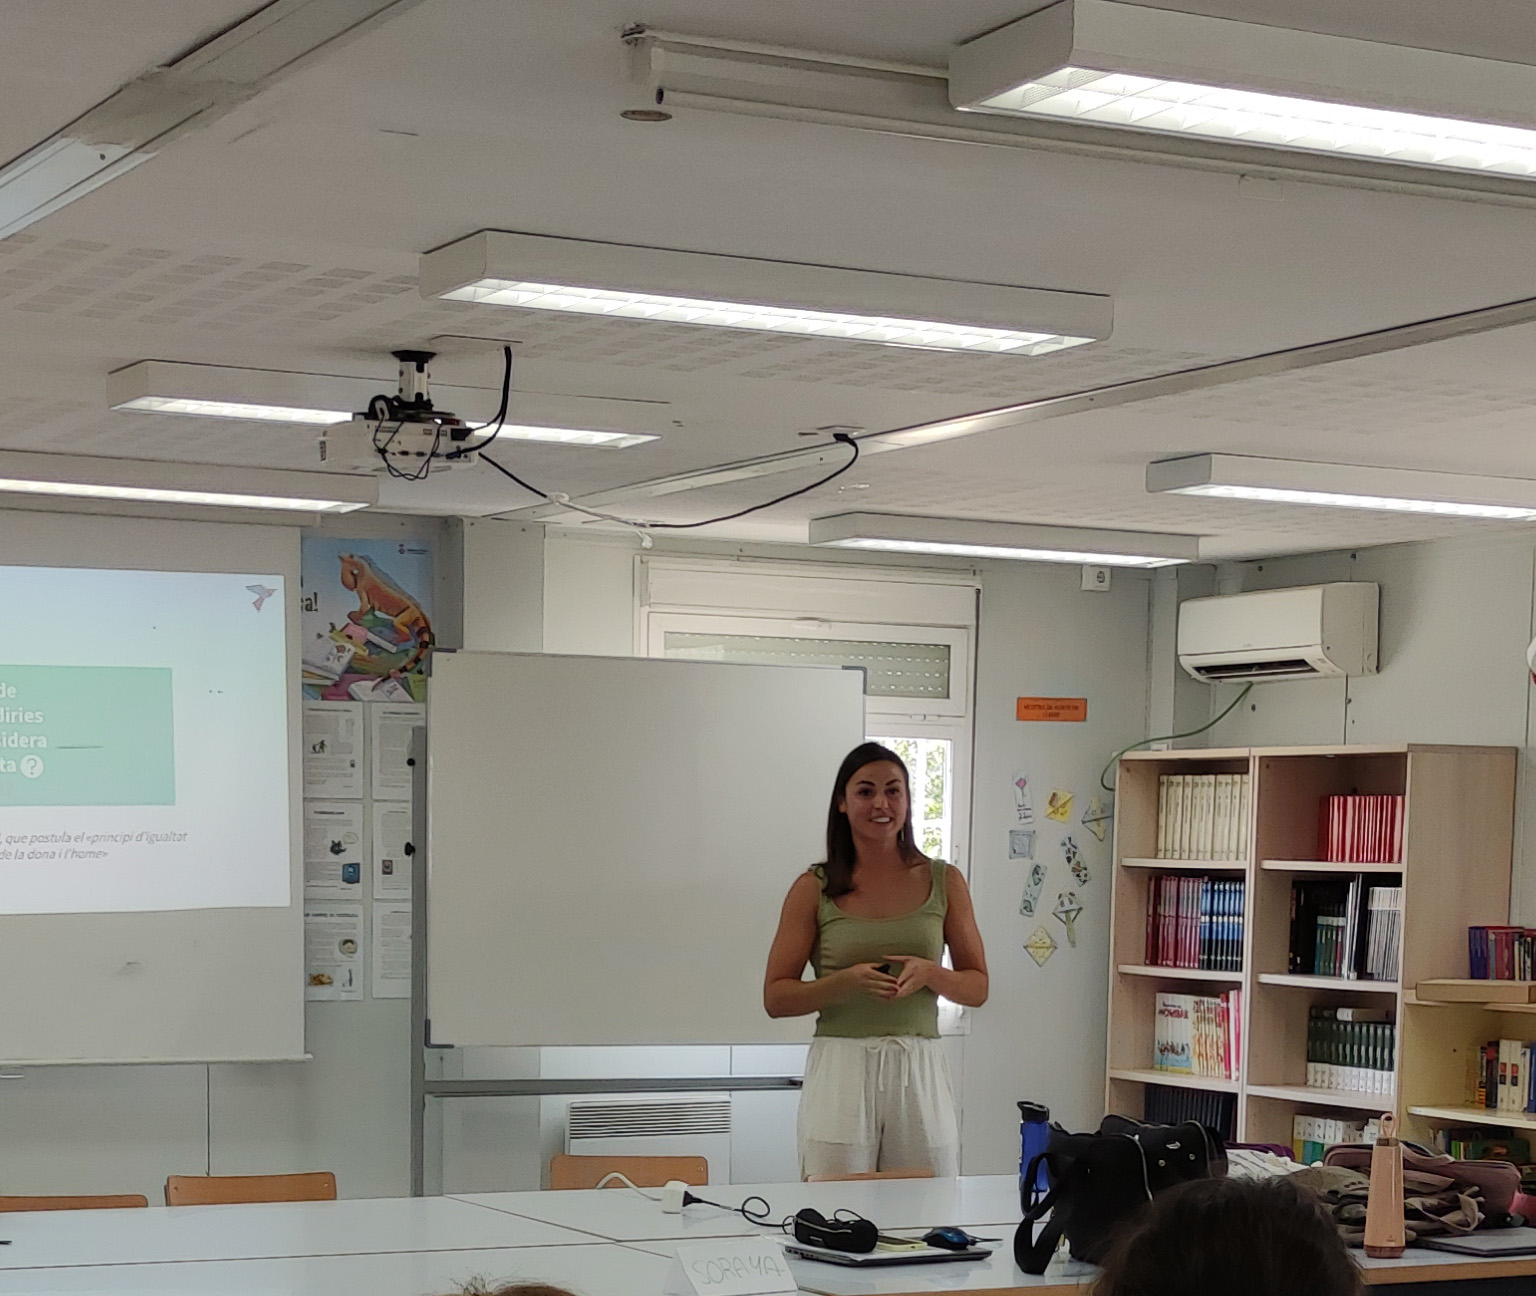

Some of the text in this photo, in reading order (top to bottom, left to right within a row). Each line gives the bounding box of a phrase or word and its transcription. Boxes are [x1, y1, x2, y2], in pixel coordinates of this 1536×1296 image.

[5, 834, 28, 847] que
[28, 831, 72, 847] postula
[73, 832, 85, 844] el
[14, 849, 25, 860] la
[27, 849, 60, 861] dona
[691, 1255, 786, 1285] SORAYA
